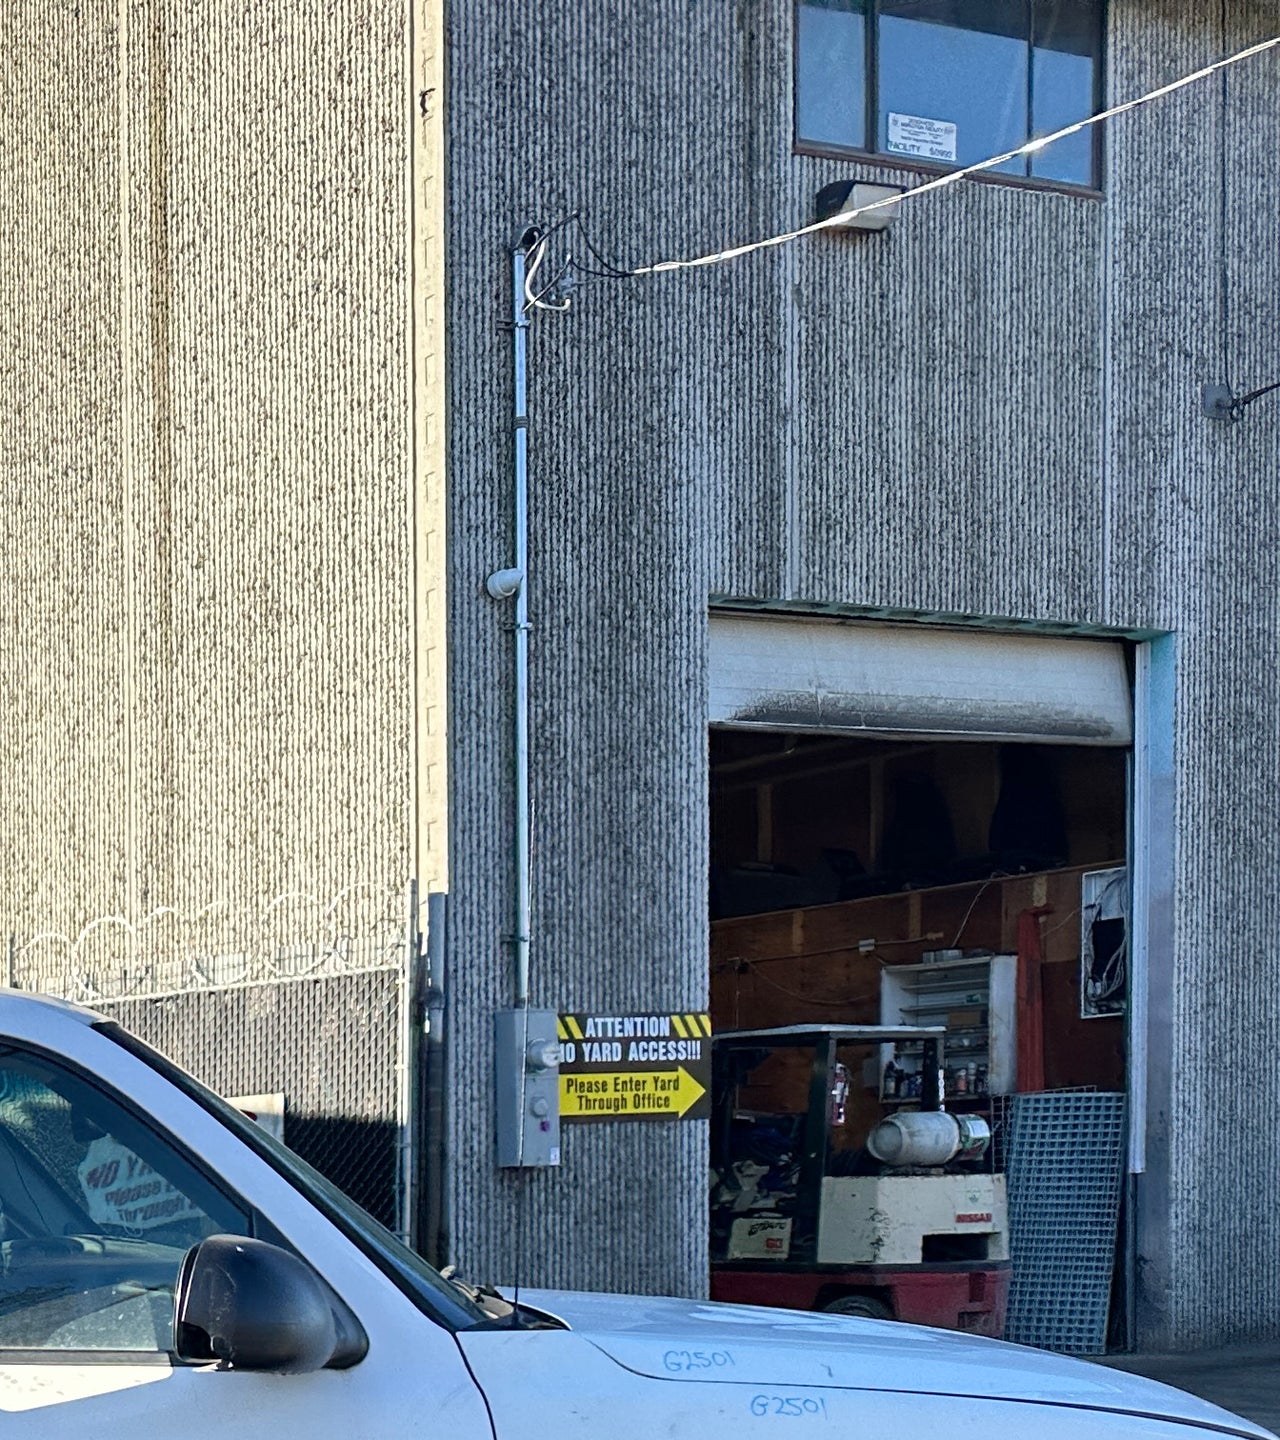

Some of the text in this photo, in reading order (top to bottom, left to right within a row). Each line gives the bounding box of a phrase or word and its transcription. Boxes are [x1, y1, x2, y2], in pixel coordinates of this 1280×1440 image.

[585, 1016, 671, 1038] ATTENTION
[582, 1041, 622, 1063] YARD
[628, 1040, 701, 1062] ACCESS!!!
[566, 1075, 680, 1094] Please Enter Yard
[577, 1093, 671, 1112] Through Office
[663, 1350, 736, 1372] G2501
[750, 1394, 829, 1421] G2501
